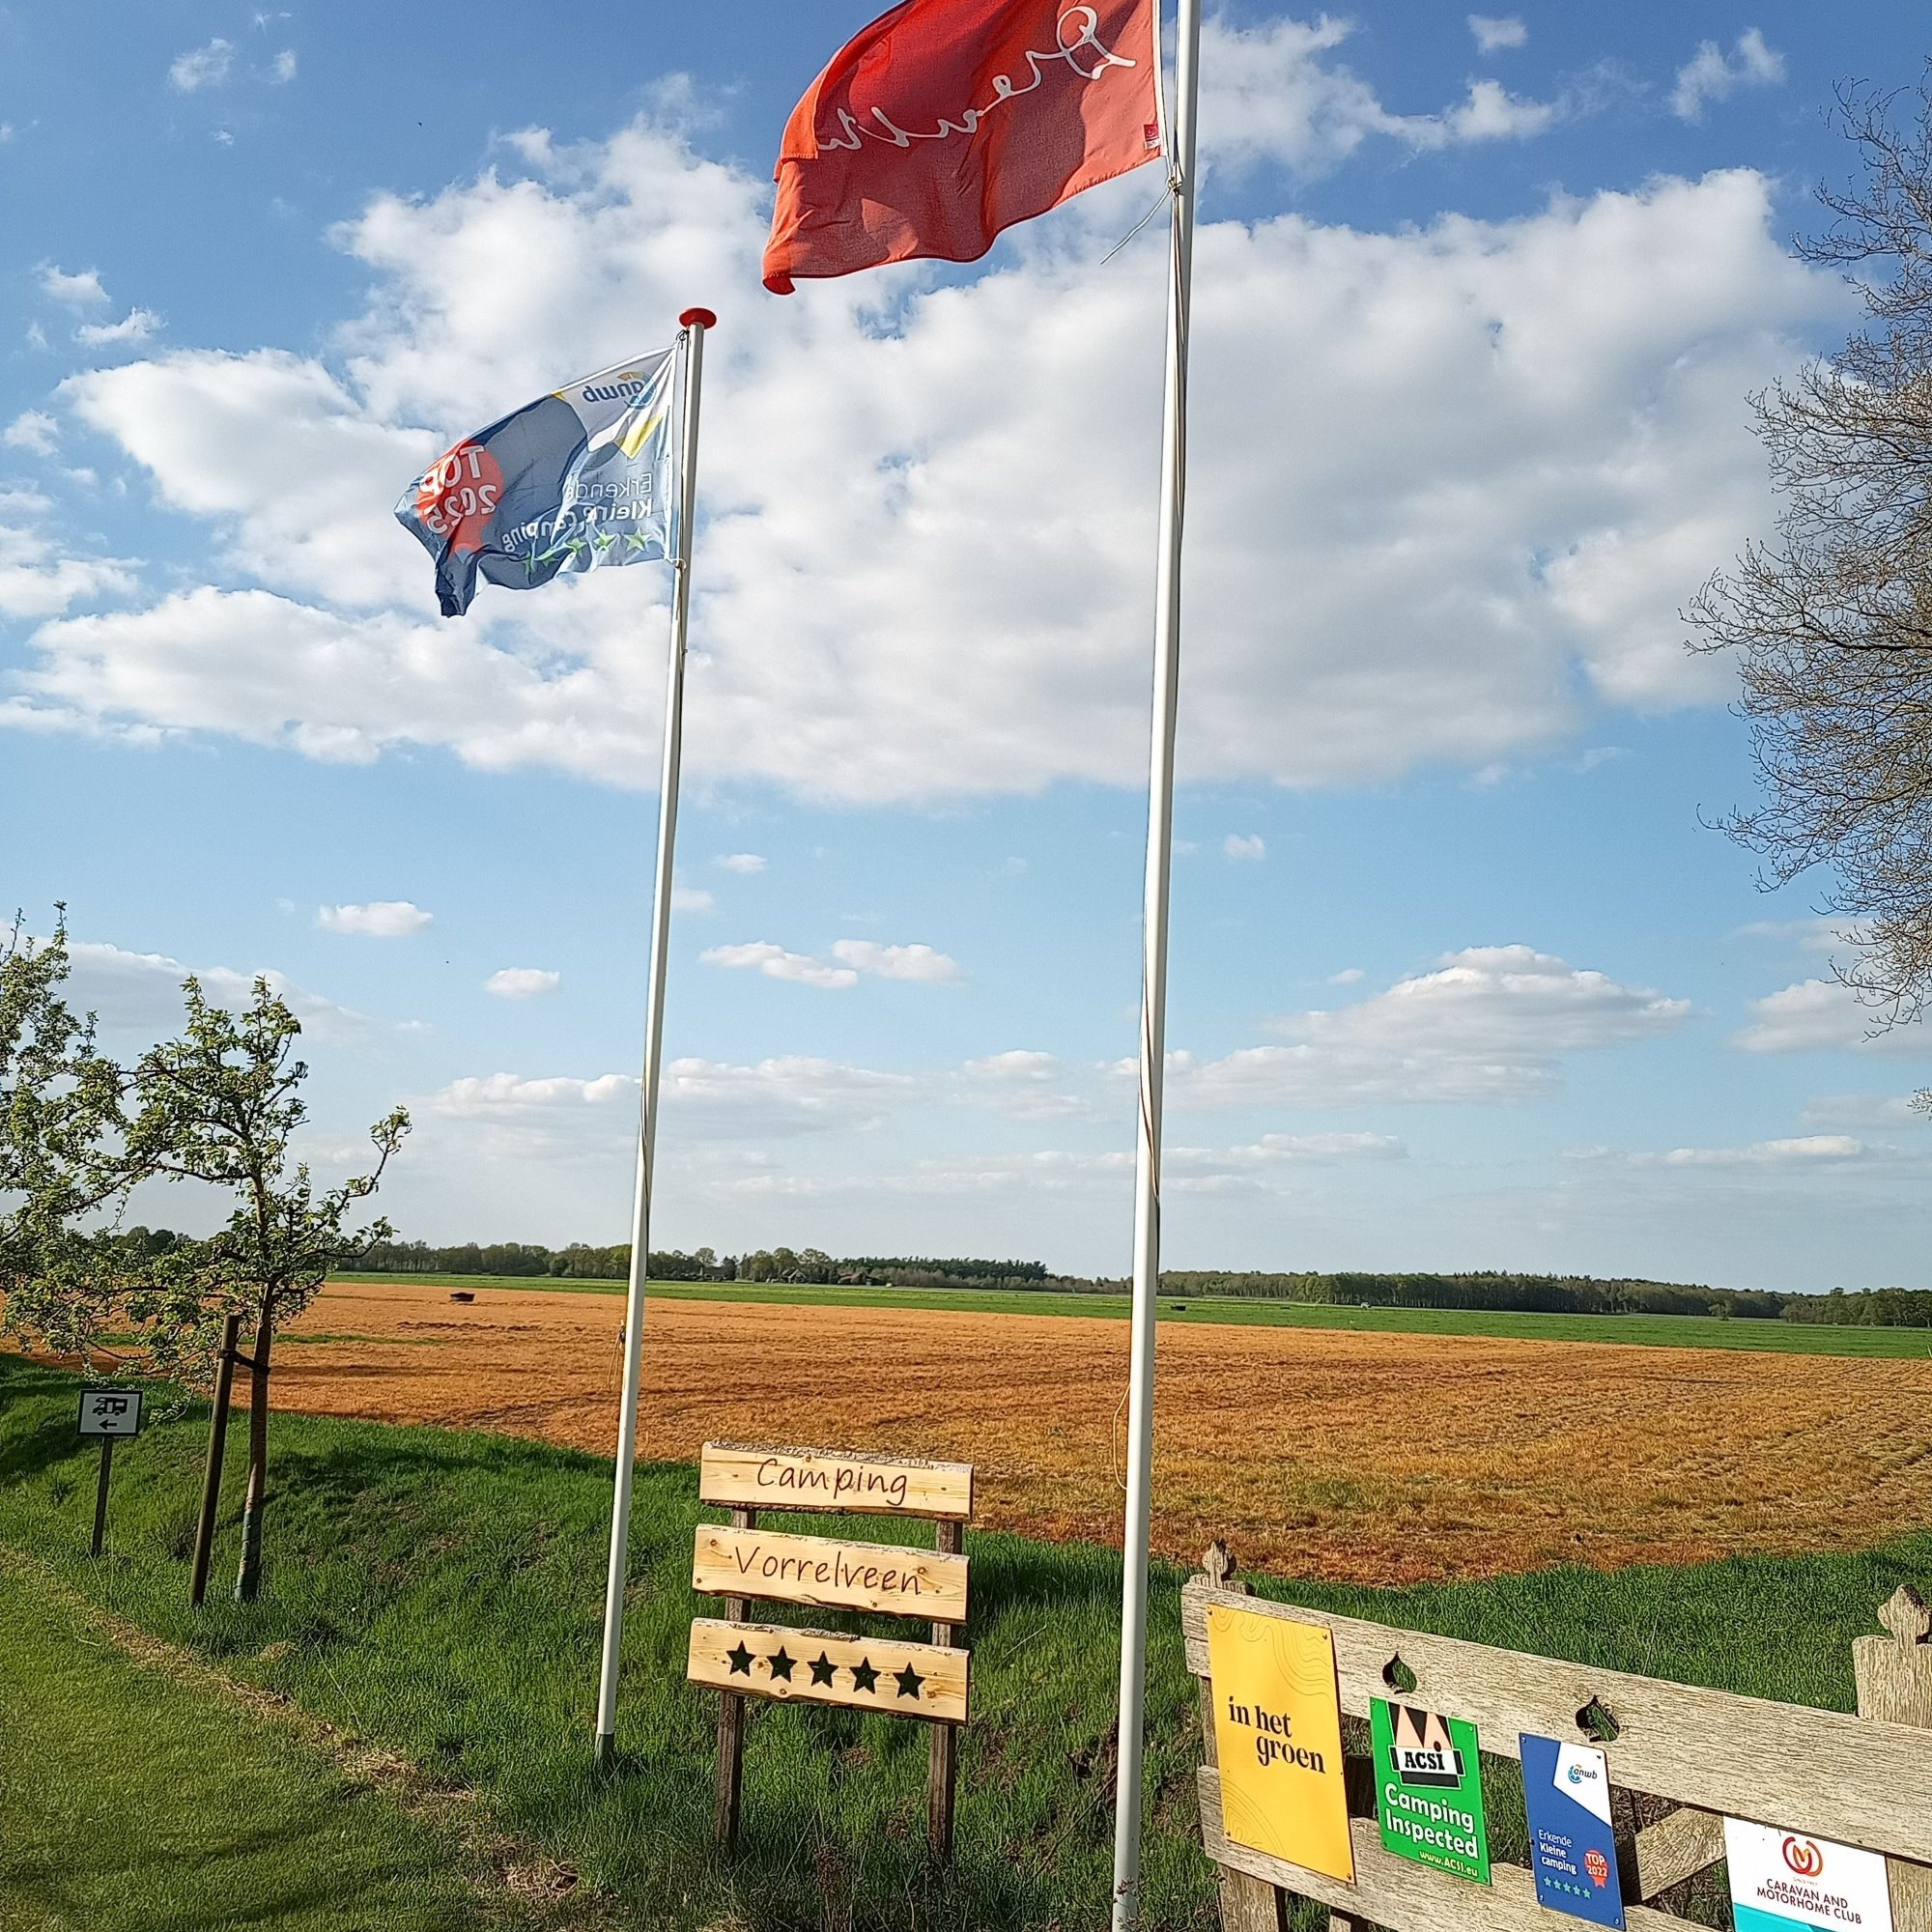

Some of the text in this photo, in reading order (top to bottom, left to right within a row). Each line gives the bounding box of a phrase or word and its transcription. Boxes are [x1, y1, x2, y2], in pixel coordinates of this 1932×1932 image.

[757, 1458, 908, 1506] Camping
[734, 1546, 922, 1596] Vorrelveen
[1228, 1695, 1293, 1738] in het
[1256, 1736, 1326, 1775] groen
[1573, 1767, 1598, 1779] anwb
[1384, 1782, 1475, 1834] Camping
[1385, 1808, 1480, 1860] Inspected
[1538, 1829, 1573, 1848] Erkende
[1540, 1842, 1567, 1859] Kleine
[1541, 1856, 1577, 1875] camping
[1585, 1853, 1605, 1866] TOP
[1587, 1865, 1608, 1878] 2022
[1756, 1886, 1862, 1924] MOTORHOME CLUB
[1766, 1878, 1820, 1901] CARAVAN
[1823, 1893, 1848, 1909] AND
